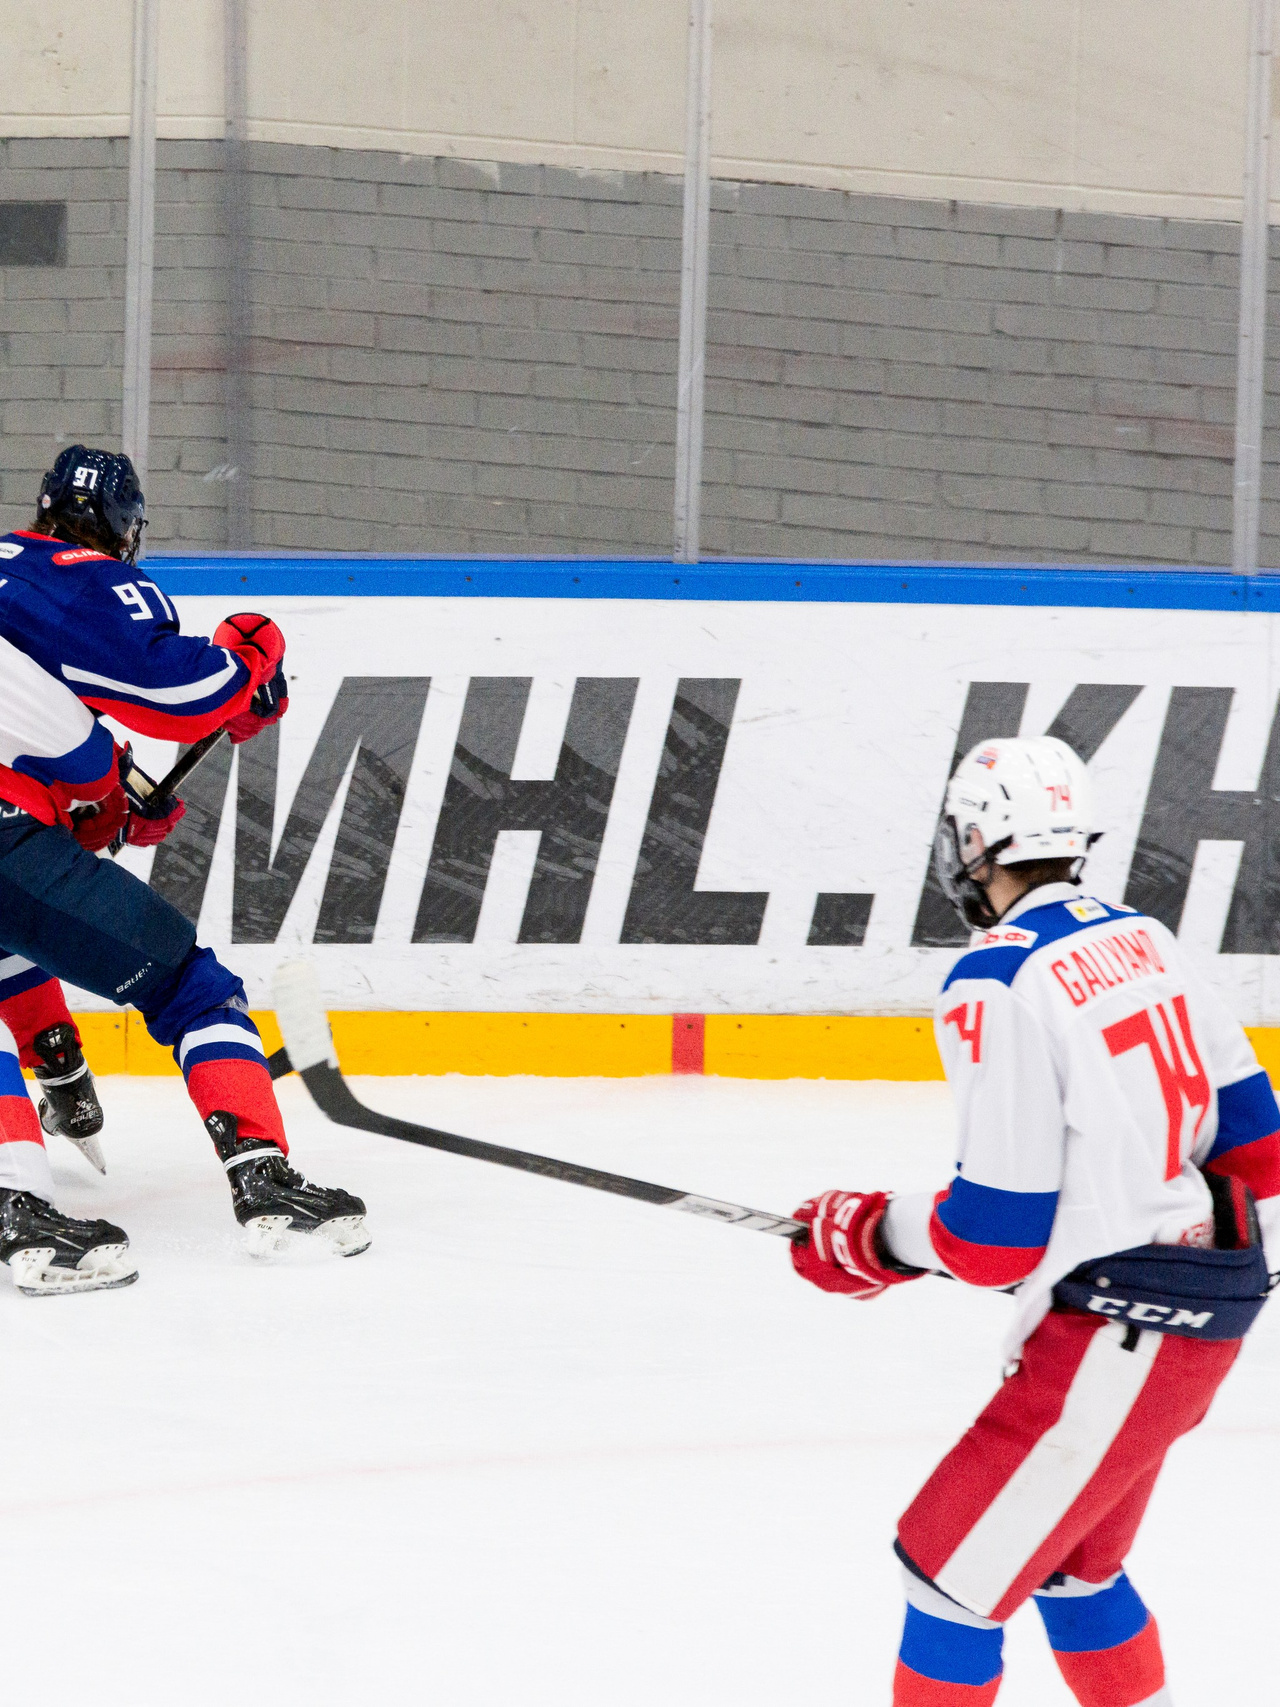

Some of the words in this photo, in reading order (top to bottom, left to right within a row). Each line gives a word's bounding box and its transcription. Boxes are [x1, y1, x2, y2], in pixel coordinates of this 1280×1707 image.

[73, 466, 98, 490] 97
[112, 580, 174, 621] 97
[1045, 784, 1072, 812] 74
[943, 1001, 985, 1064] 74
[1102, 995, 1211, 1183] 74
[1086, 1294, 1215, 1329] CCM
